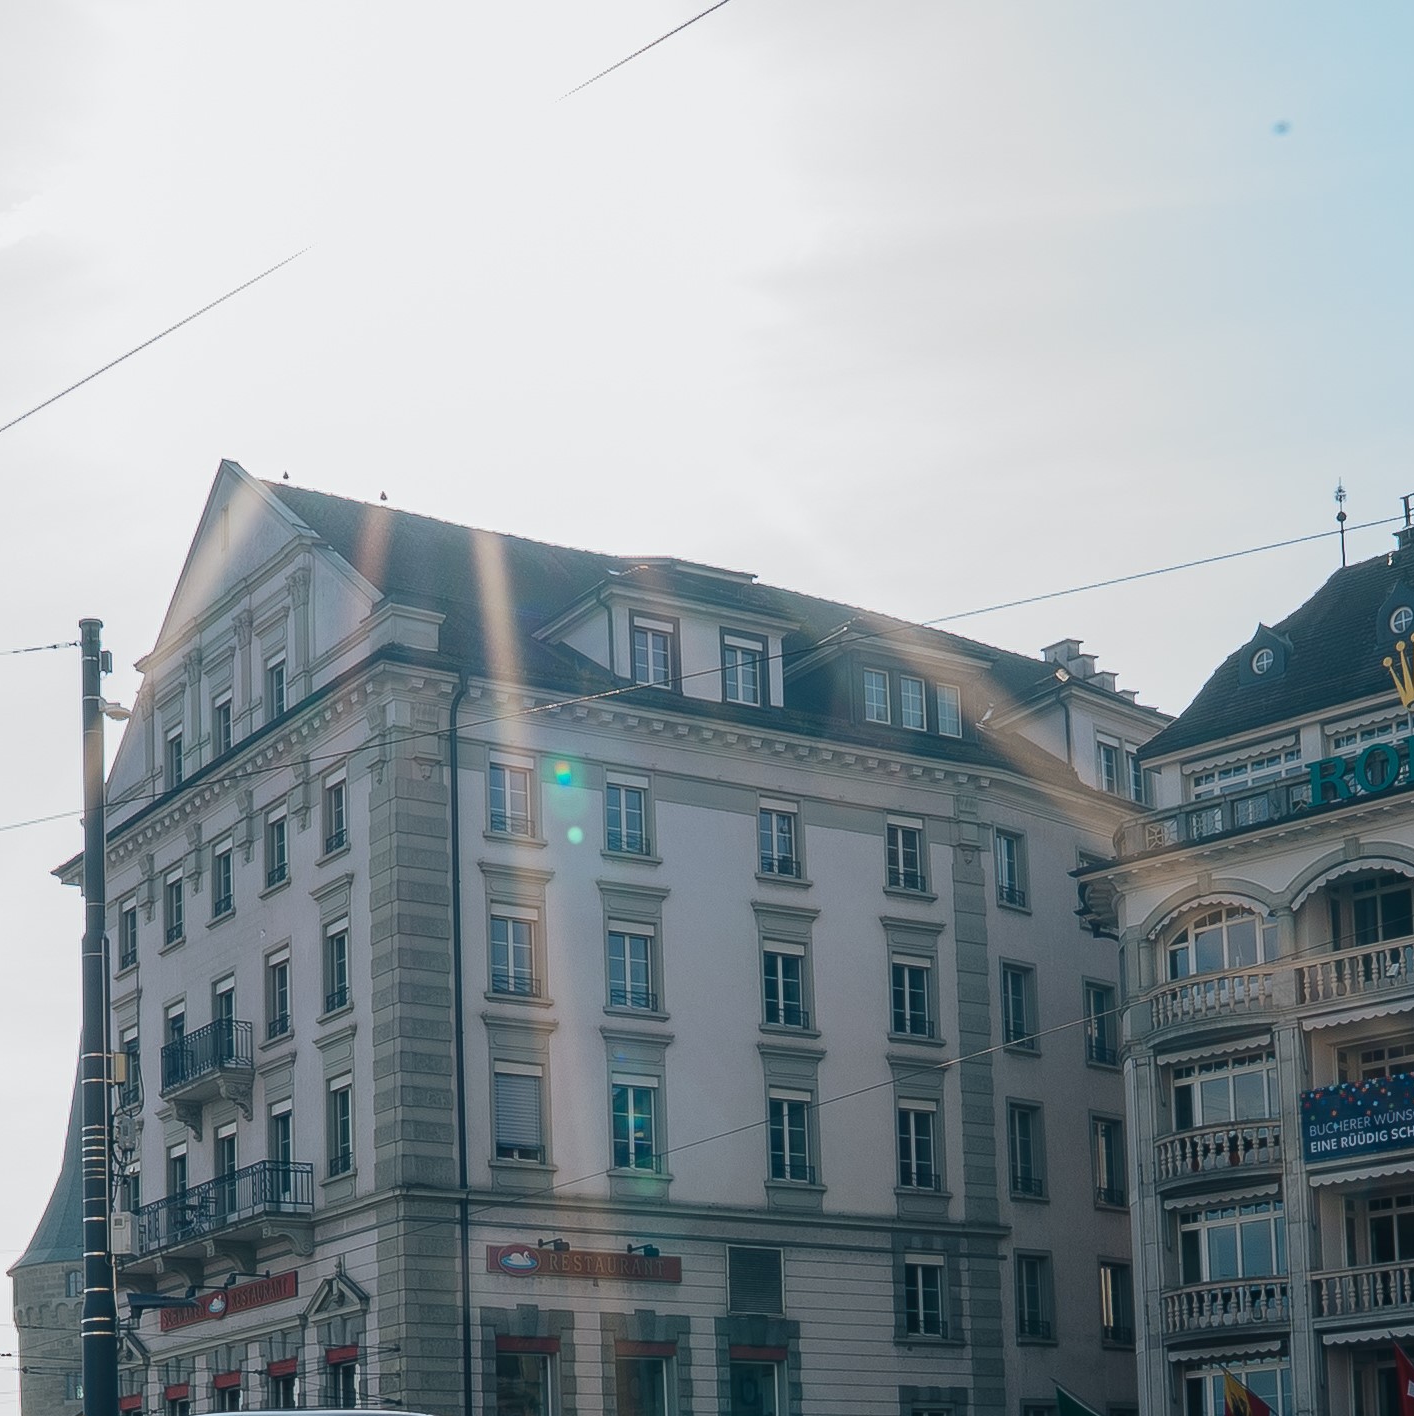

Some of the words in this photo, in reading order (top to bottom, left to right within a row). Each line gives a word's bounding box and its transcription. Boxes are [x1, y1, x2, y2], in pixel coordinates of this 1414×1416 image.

[1309, 1116, 1372, 1137] BUCHERER
[1310, 1137, 1338, 1153] EINE
[1340, 1129, 1389, 1149] RÜÜDIG
[549, 1253, 665, 1277] RESTAURANT
[231, 1278, 289, 1309] RESTAURANT
